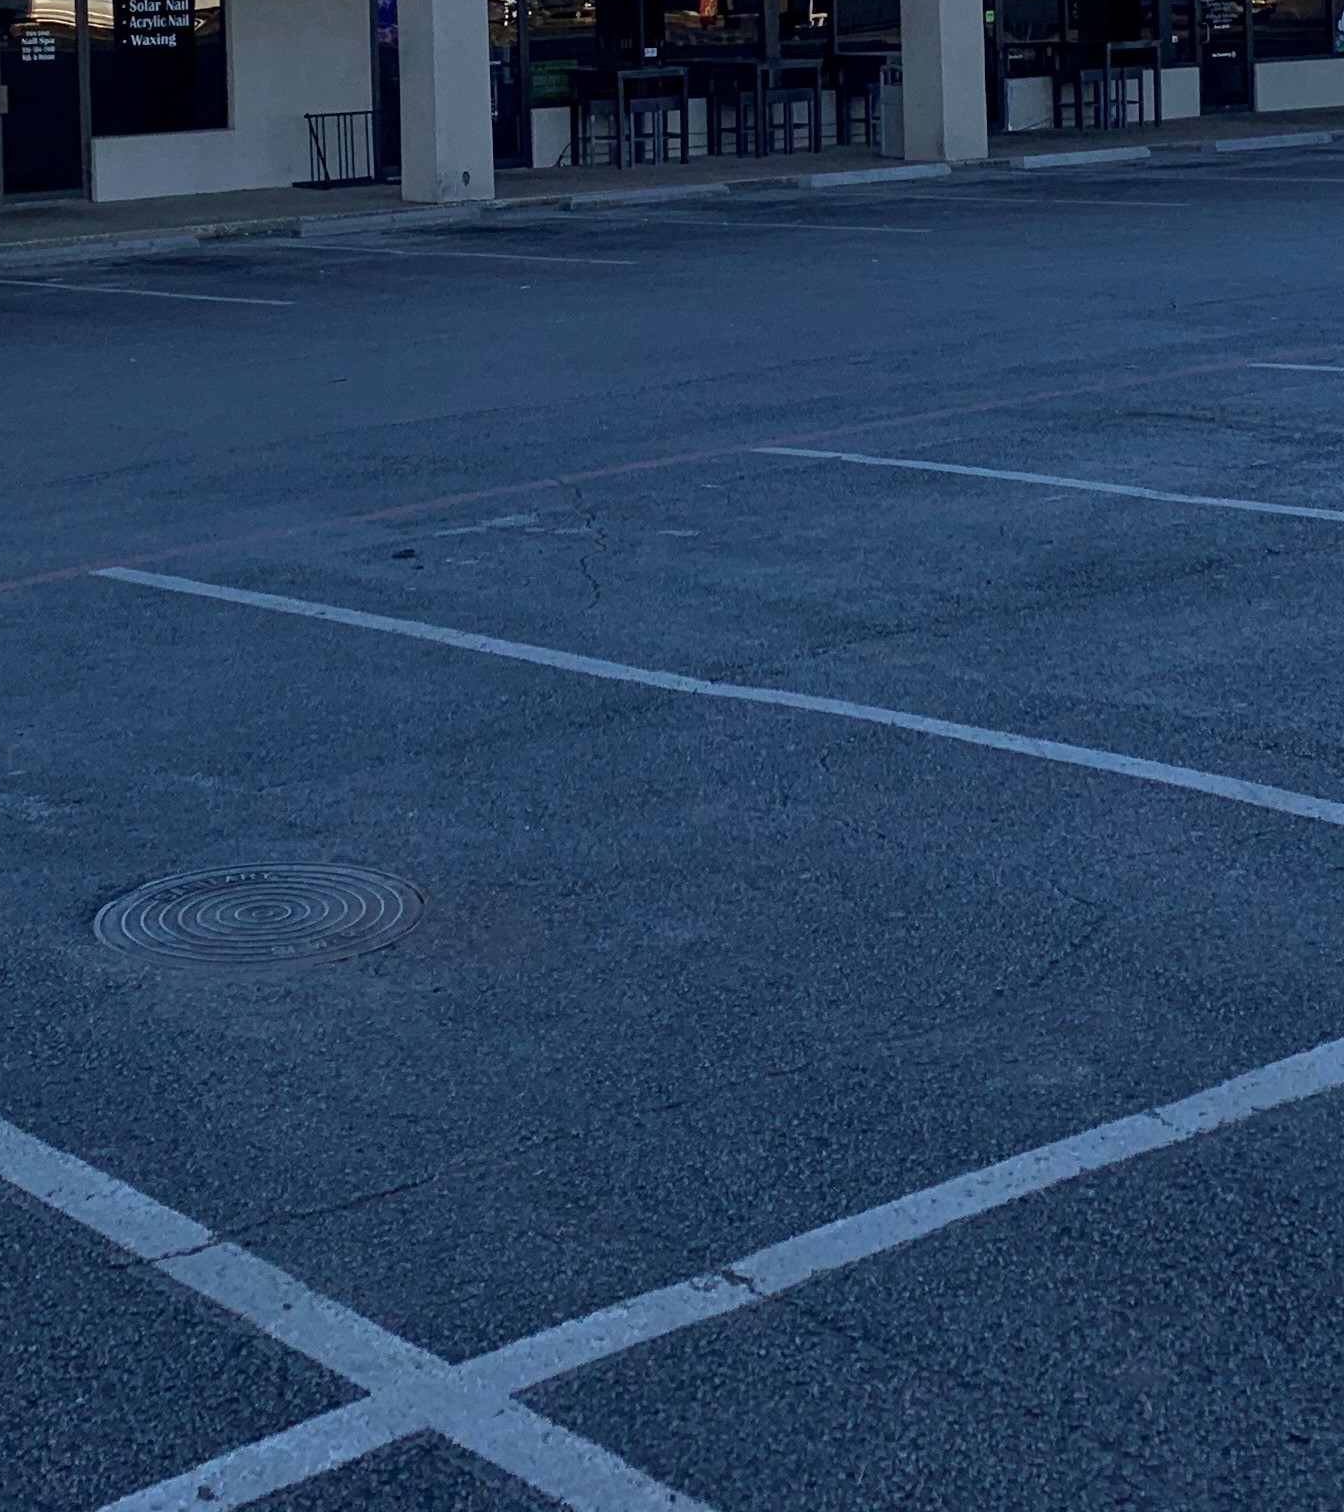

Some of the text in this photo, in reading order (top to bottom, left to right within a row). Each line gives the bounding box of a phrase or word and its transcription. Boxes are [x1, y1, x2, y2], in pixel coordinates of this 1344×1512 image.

[129, 13, 190, 31] Acrylic Nail
[130, 32, 177, 48] Waxing
